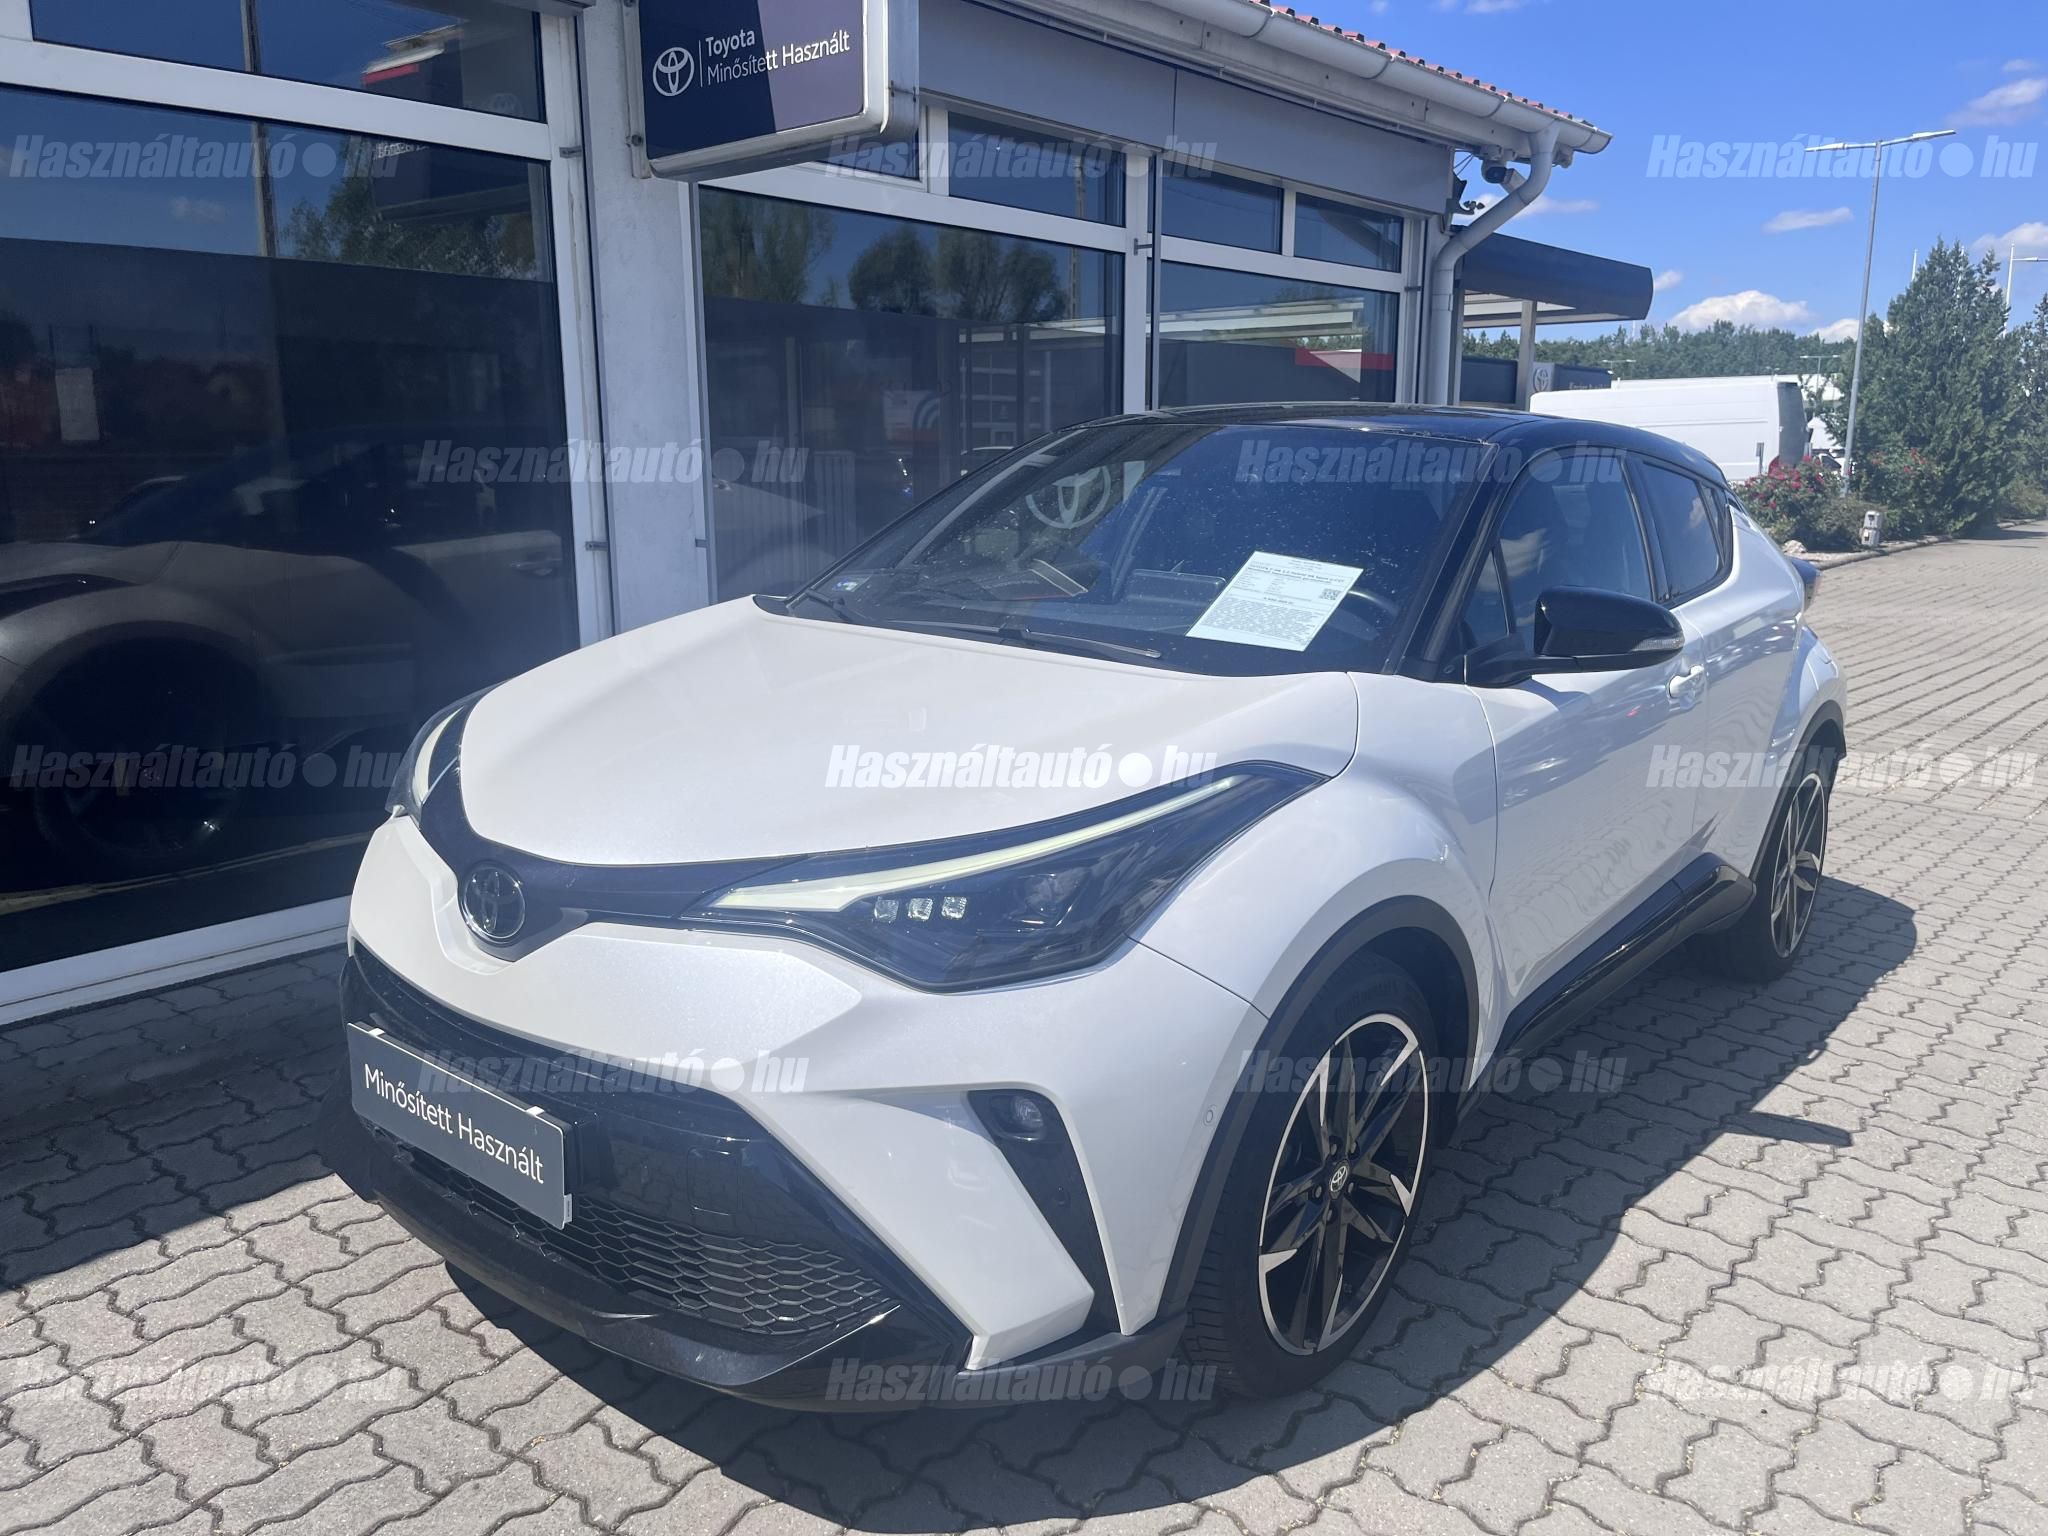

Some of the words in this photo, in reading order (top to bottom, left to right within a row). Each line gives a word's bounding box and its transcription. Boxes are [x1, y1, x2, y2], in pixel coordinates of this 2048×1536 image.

[706, 29, 755, 58] Toyota
[707, 50, 779, 85] Minősített
[782, 29, 850, 67] Használt
[364, 1063, 453, 1134] Minősített
[458, 1112, 544, 1184] Használt
